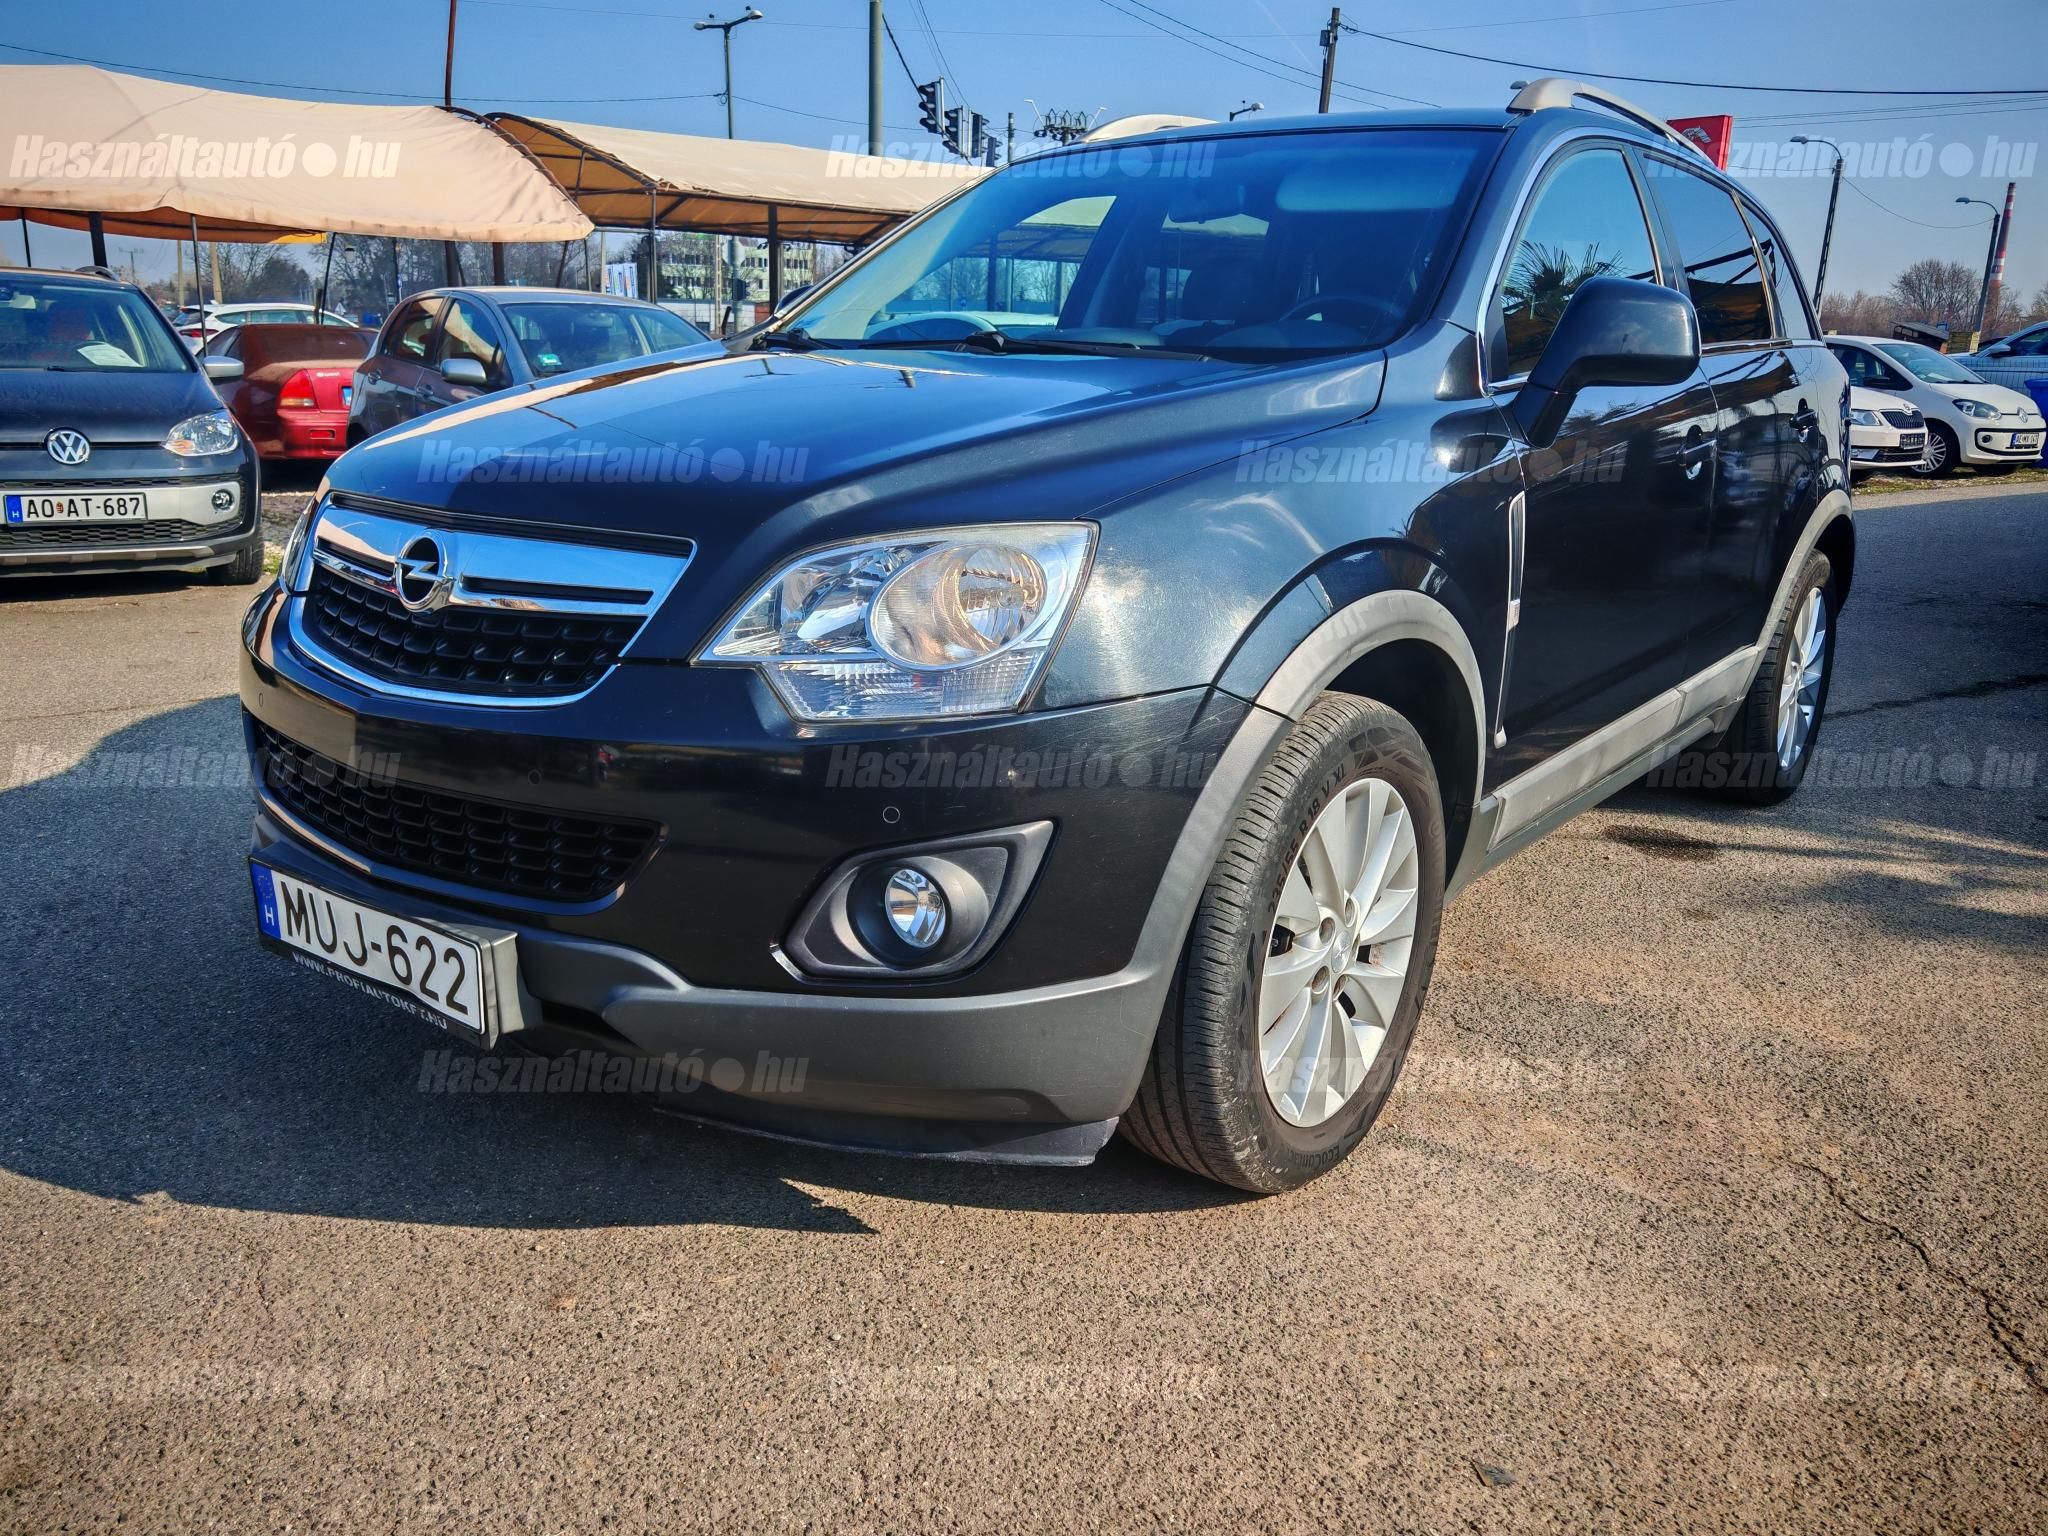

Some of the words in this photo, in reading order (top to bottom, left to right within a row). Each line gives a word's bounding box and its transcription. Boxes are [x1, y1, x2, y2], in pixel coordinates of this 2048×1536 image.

[26, 498, 55, 519] AO
[66, 497, 141, 518] AT-687
[263, 903, 276, 927] H
[280, 880, 469, 1016] MUJ-622
